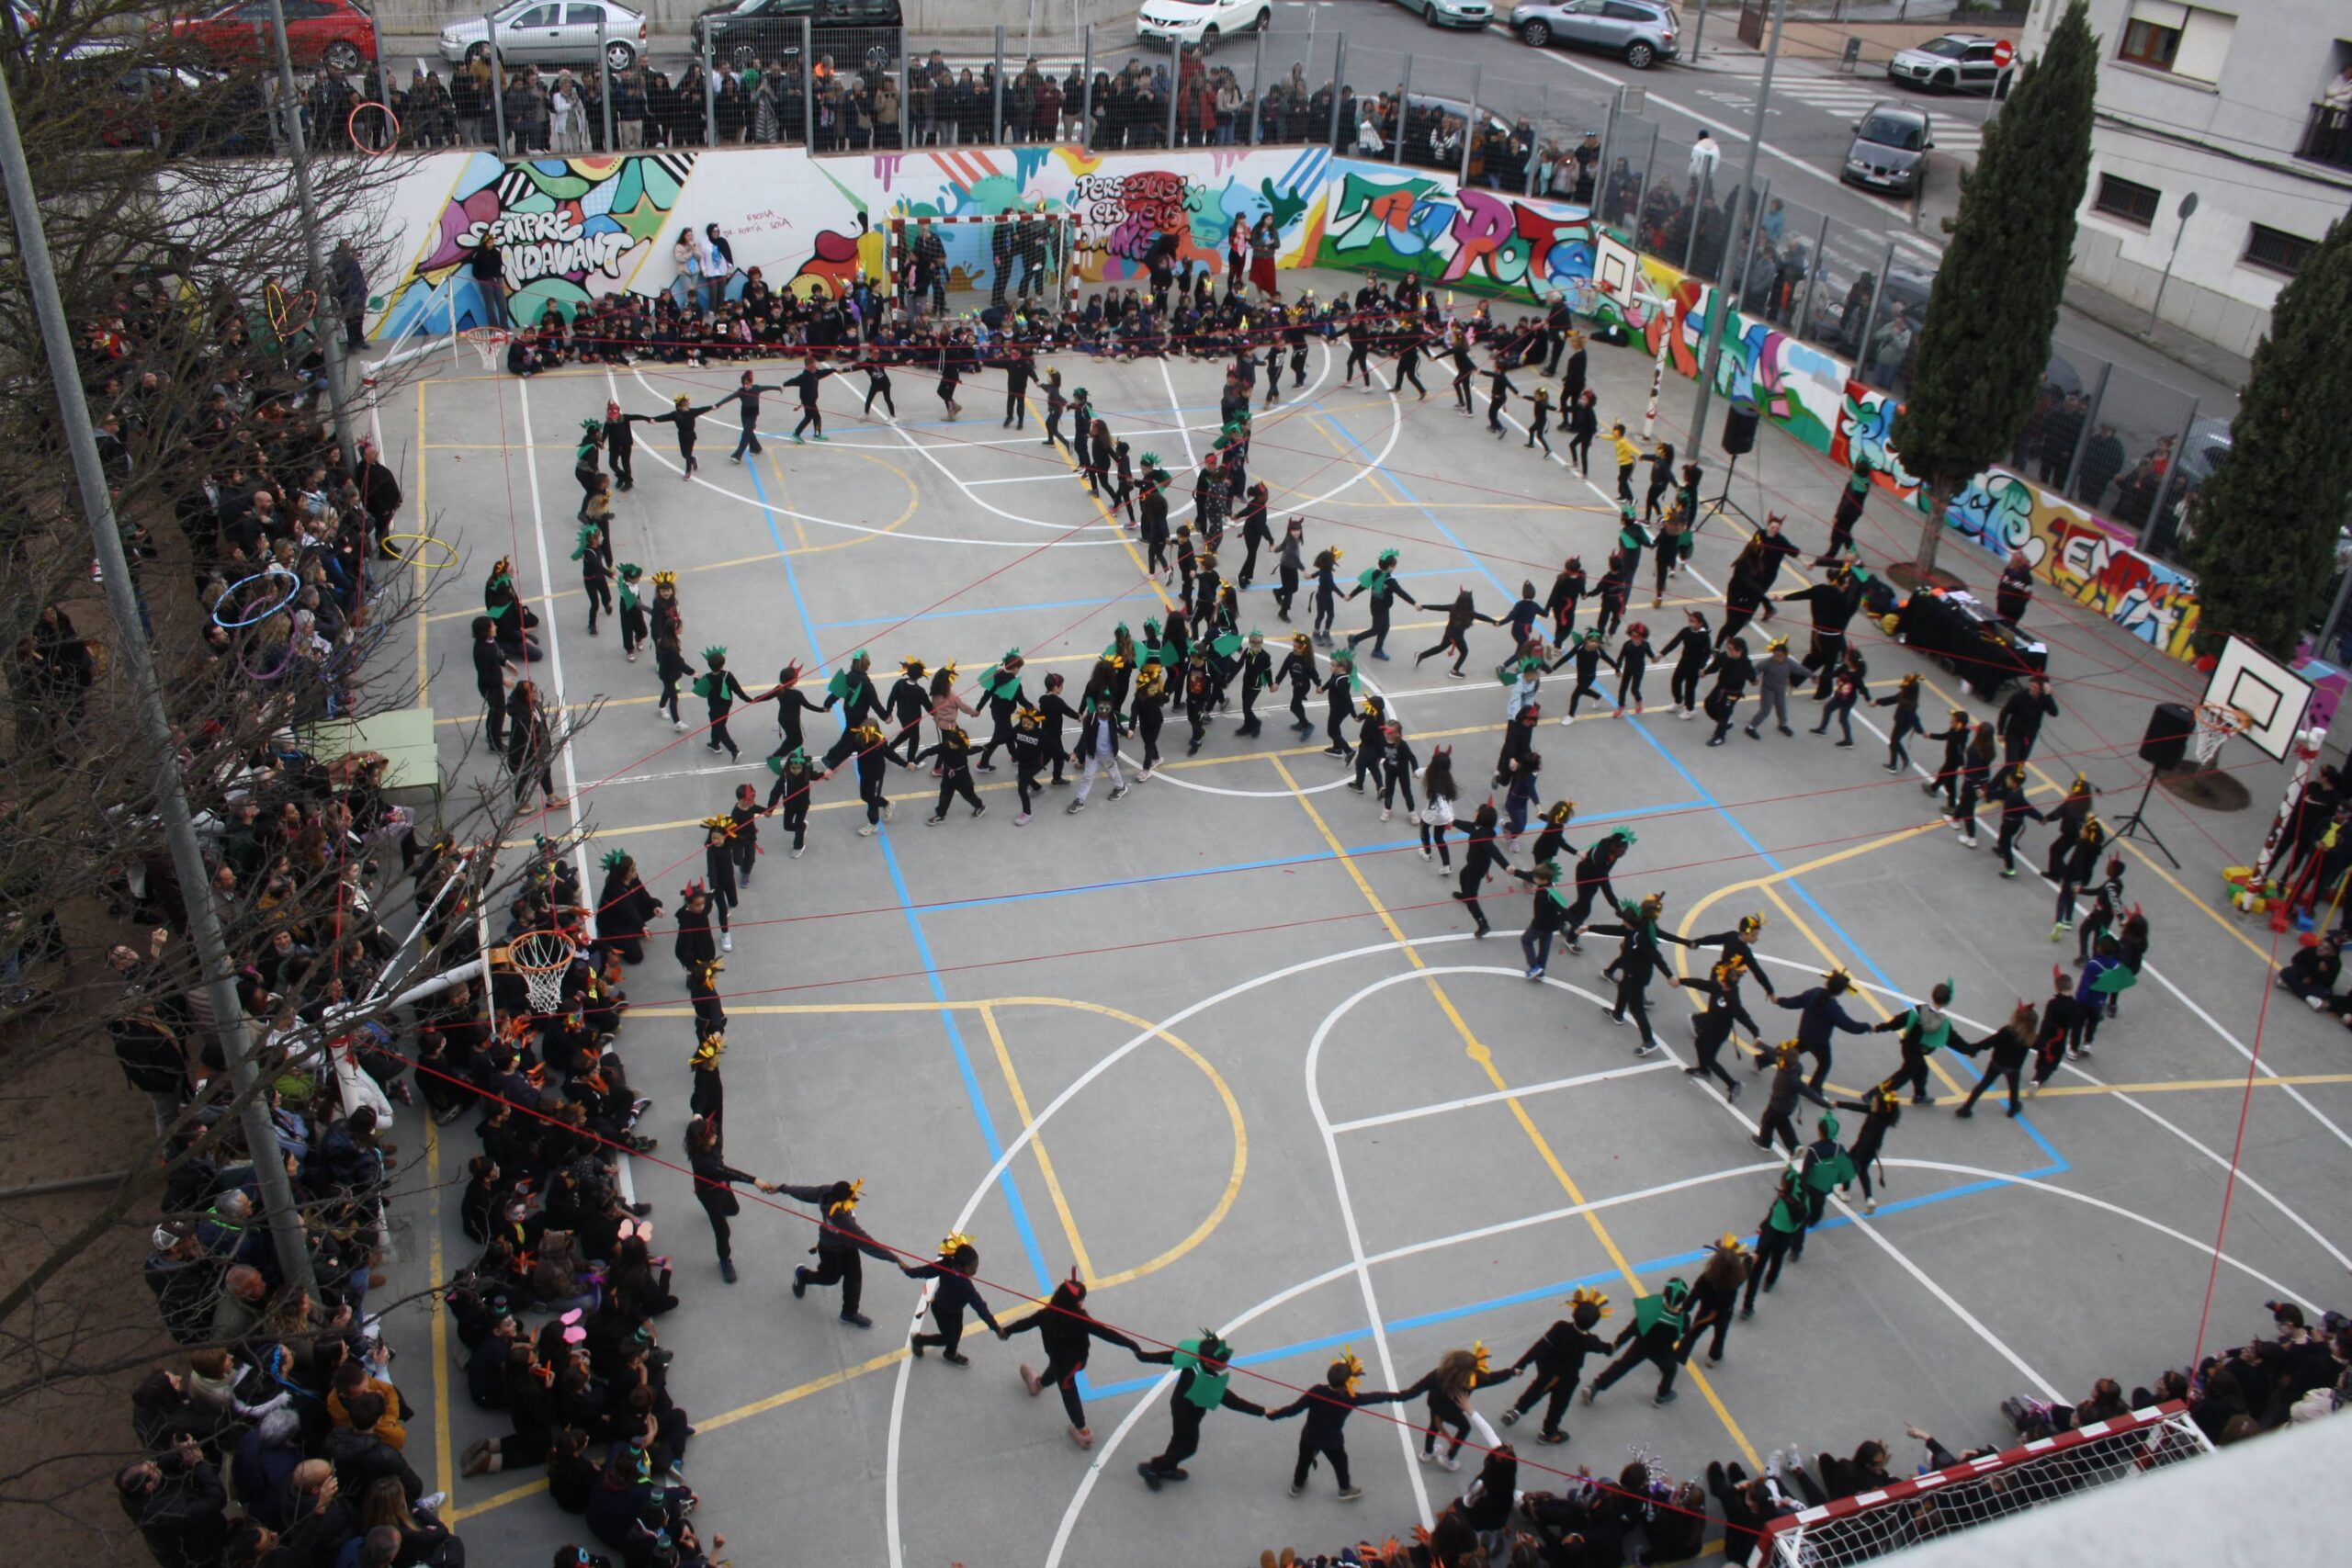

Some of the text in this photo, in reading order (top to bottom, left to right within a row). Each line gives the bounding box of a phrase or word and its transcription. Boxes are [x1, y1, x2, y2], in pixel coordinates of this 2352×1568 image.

[457, 210, 584, 247] SEMPRE
[746, 209, 775, 221] ESCOLA
[502, 231, 635, 291] NDAVANT
